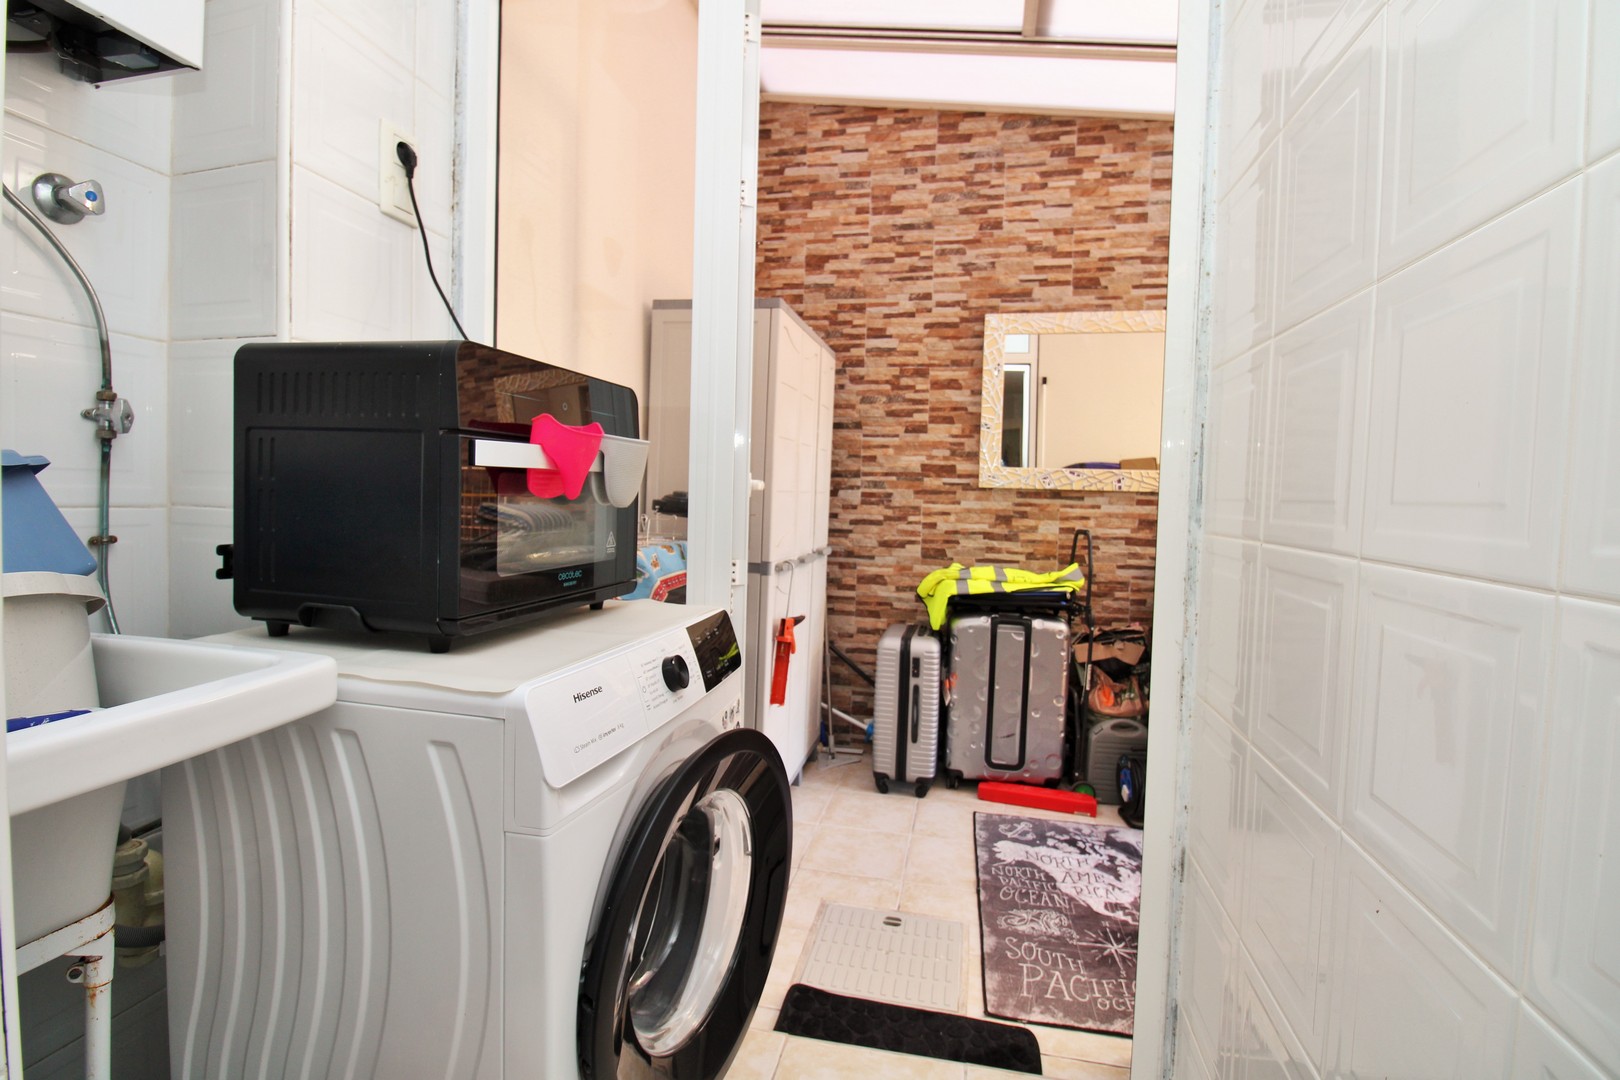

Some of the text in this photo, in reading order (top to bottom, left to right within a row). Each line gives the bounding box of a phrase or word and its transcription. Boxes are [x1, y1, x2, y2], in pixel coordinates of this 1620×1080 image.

[573, 684, 603, 704] Hisense
[1025, 850, 1091, 869] NORTH
[991, 865, 1046, 881] NORTH
[1000, 877, 1057, 892] PACIFIC
[999, 886, 1069, 909] OCEAN
[1005, 936, 1086, 975] SOUTH
